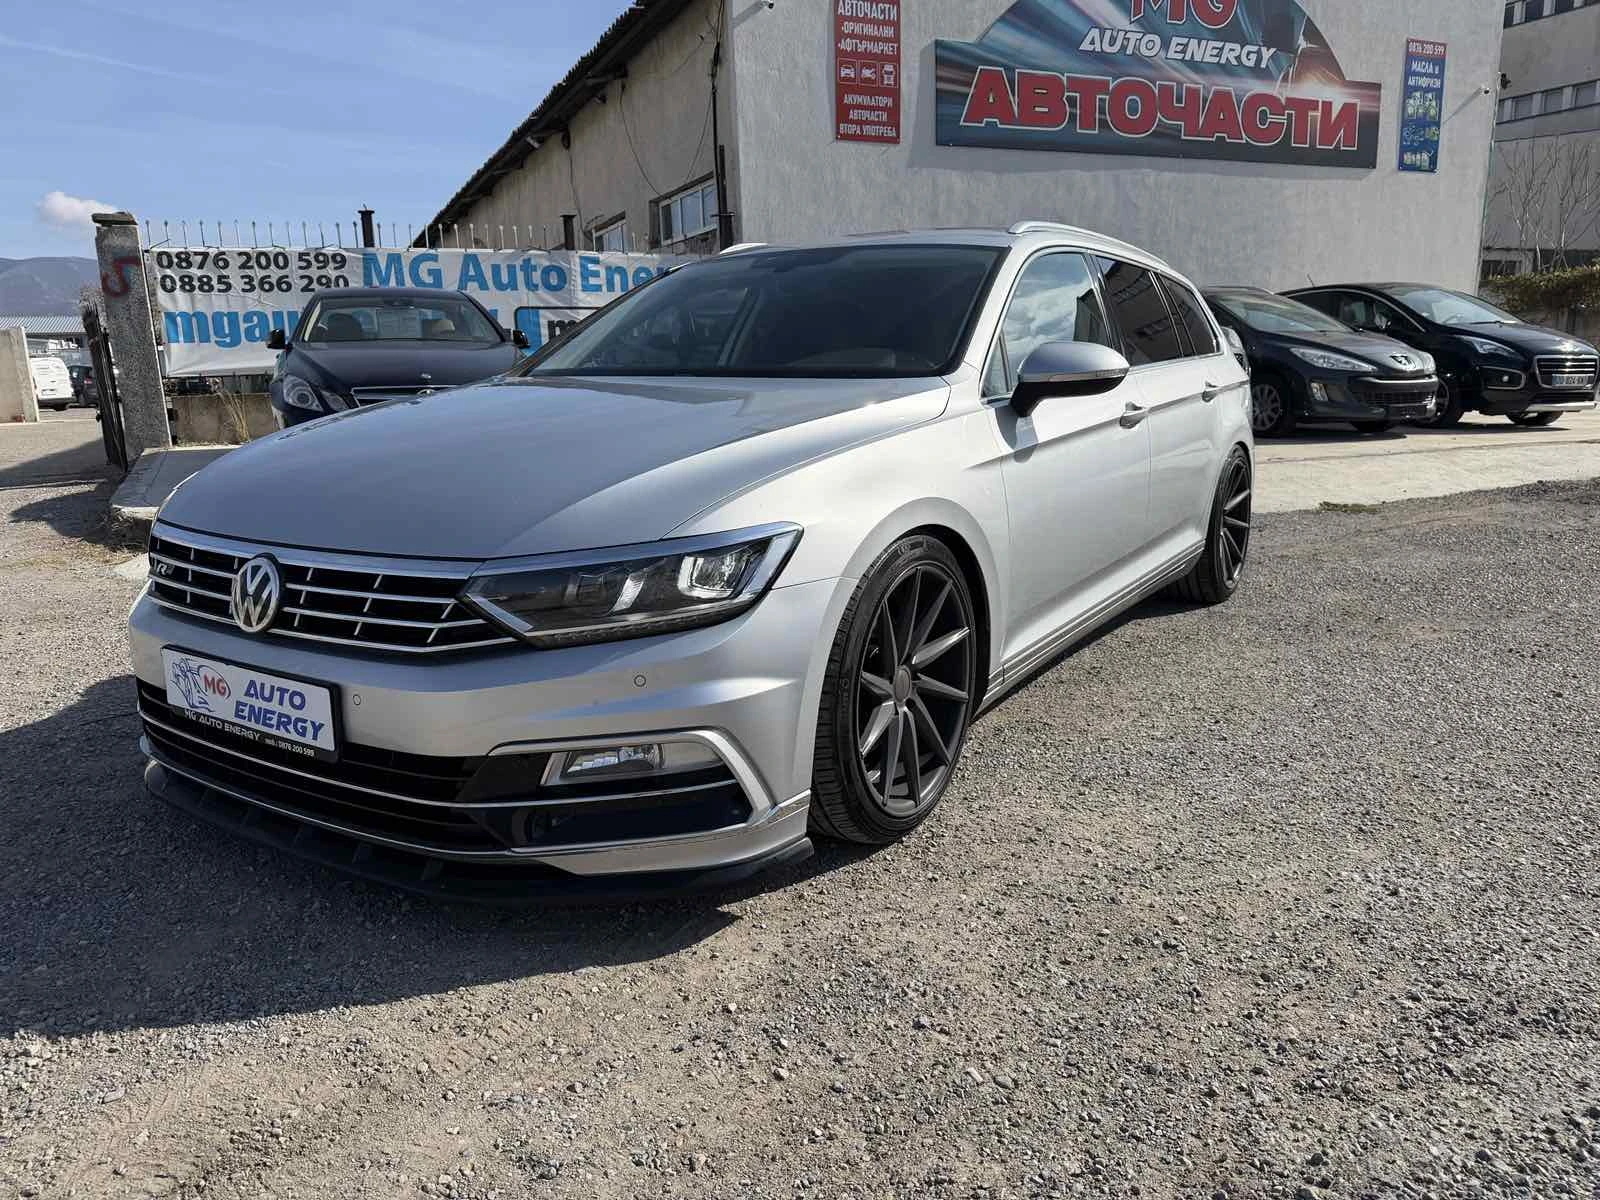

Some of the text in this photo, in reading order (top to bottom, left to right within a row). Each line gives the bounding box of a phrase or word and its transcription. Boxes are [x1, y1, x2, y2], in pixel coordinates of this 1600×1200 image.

[838, 0, 897, 21] АВТОЧАСТИ
[1079, 26, 1277, 69] AUTO ENERGY
[1423, 43, 1434, 54] 200
[1434, 44, 1444, 55] 599
[1411, 60, 1433, 74] МАСЛА
[843, 94, 893, 108] АКУМУЛАТОРИ
[960, 66, 1360, 150] АВТОЧАСТИ
[848, 109, 888, 122] АВТОЧАСТИ
[839, 123, 897, 137] ВТОРА УПОТРЕБА
[156, 251, 347, 271] 0876 200 599
[362, 253, 443, 289] MG
[457, 254, 568, 292] Auto
[160, 274, 350, 294] 0885 366 290
[203, 673, 227, 697] MG
[243, 679, 306, 711] AUTO
[234, 700, 325, 741] ENERGY
[184, 709, 197, 721] MG
[199, 715, 223, 729] AUTO
[224, 723, 260, 741] ENERGY
[292, 744, 303, 754] 200
[303, 747, 315, 757] 599
